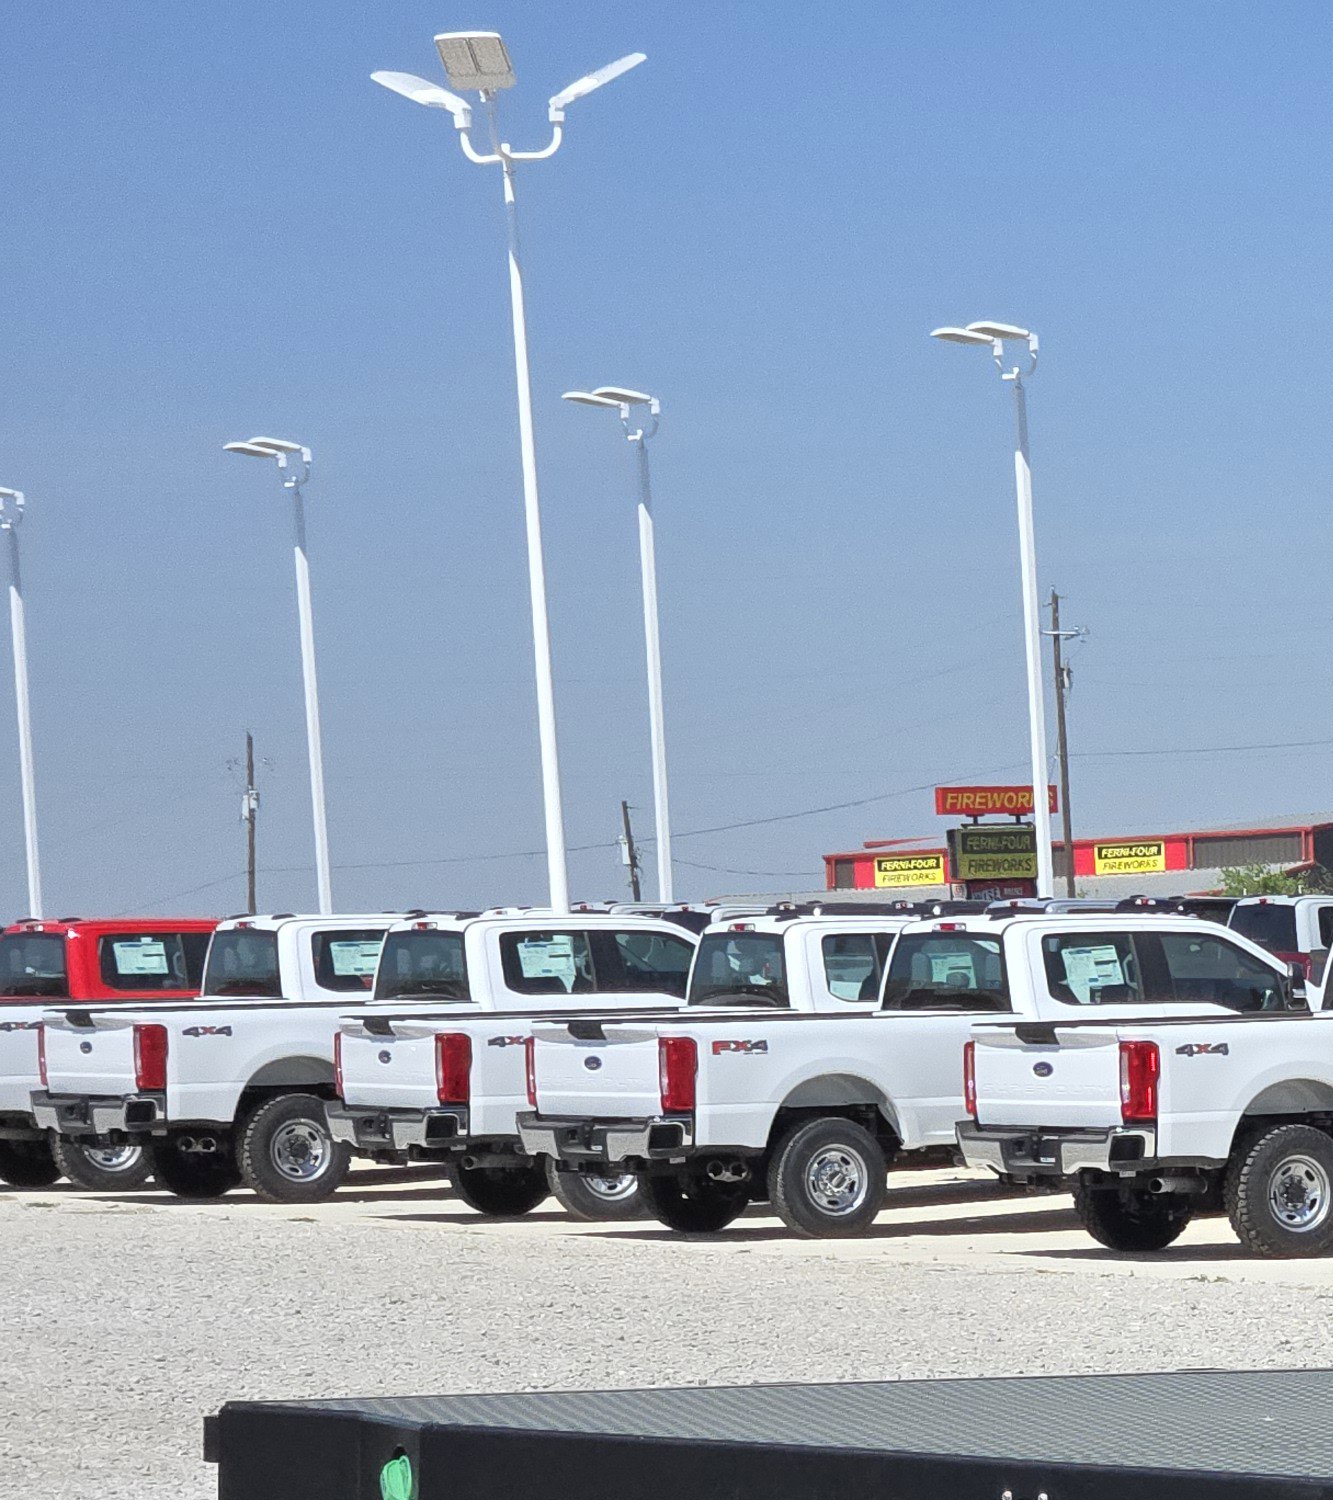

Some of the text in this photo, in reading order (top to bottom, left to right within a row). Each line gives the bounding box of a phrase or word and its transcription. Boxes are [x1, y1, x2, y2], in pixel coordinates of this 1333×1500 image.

[967, 857, 1032, 873] FIREWORKS
[1102, 859, 1159, 871] FIREWORKS
[882, 872, 937, 883] FIREWORKS
[712, 1039, 769, 1056] FX4
